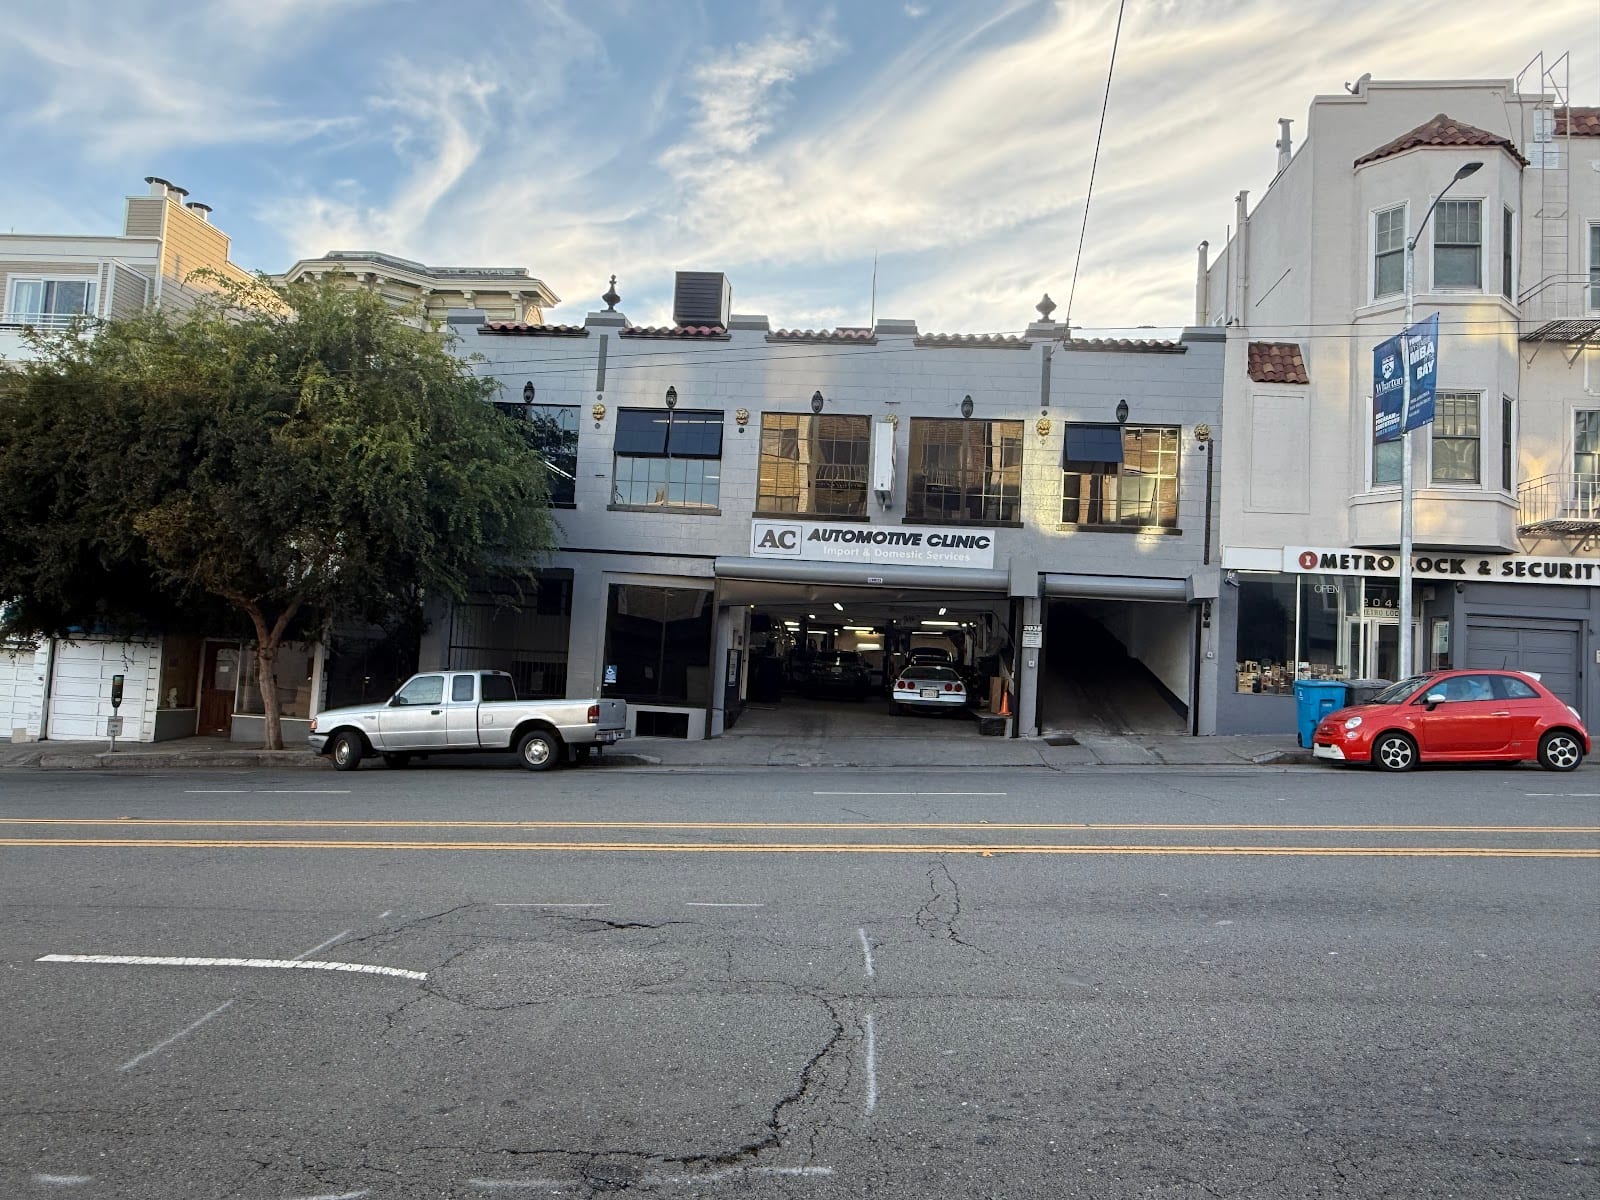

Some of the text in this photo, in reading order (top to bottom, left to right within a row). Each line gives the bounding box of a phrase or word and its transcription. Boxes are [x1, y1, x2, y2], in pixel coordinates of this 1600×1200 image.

[1409, 342, 1435, 365] MBA
[1416, 360, 1435, 380] BAY
[1376, 377, 1403, 393] Wharton
[757, 529, 796, 549] AC
[807, 528, 991, 549] AUTOMOTIVE CLINIC
[823, 546, 970, 561] Import & Domestic Services
[1320, 553, 1394, 570] METRO
[1412, 556, 1465, 573] OCK
[1478, 560, 1492, 575] &
[1314, 585, 1339, 593] OPEN
